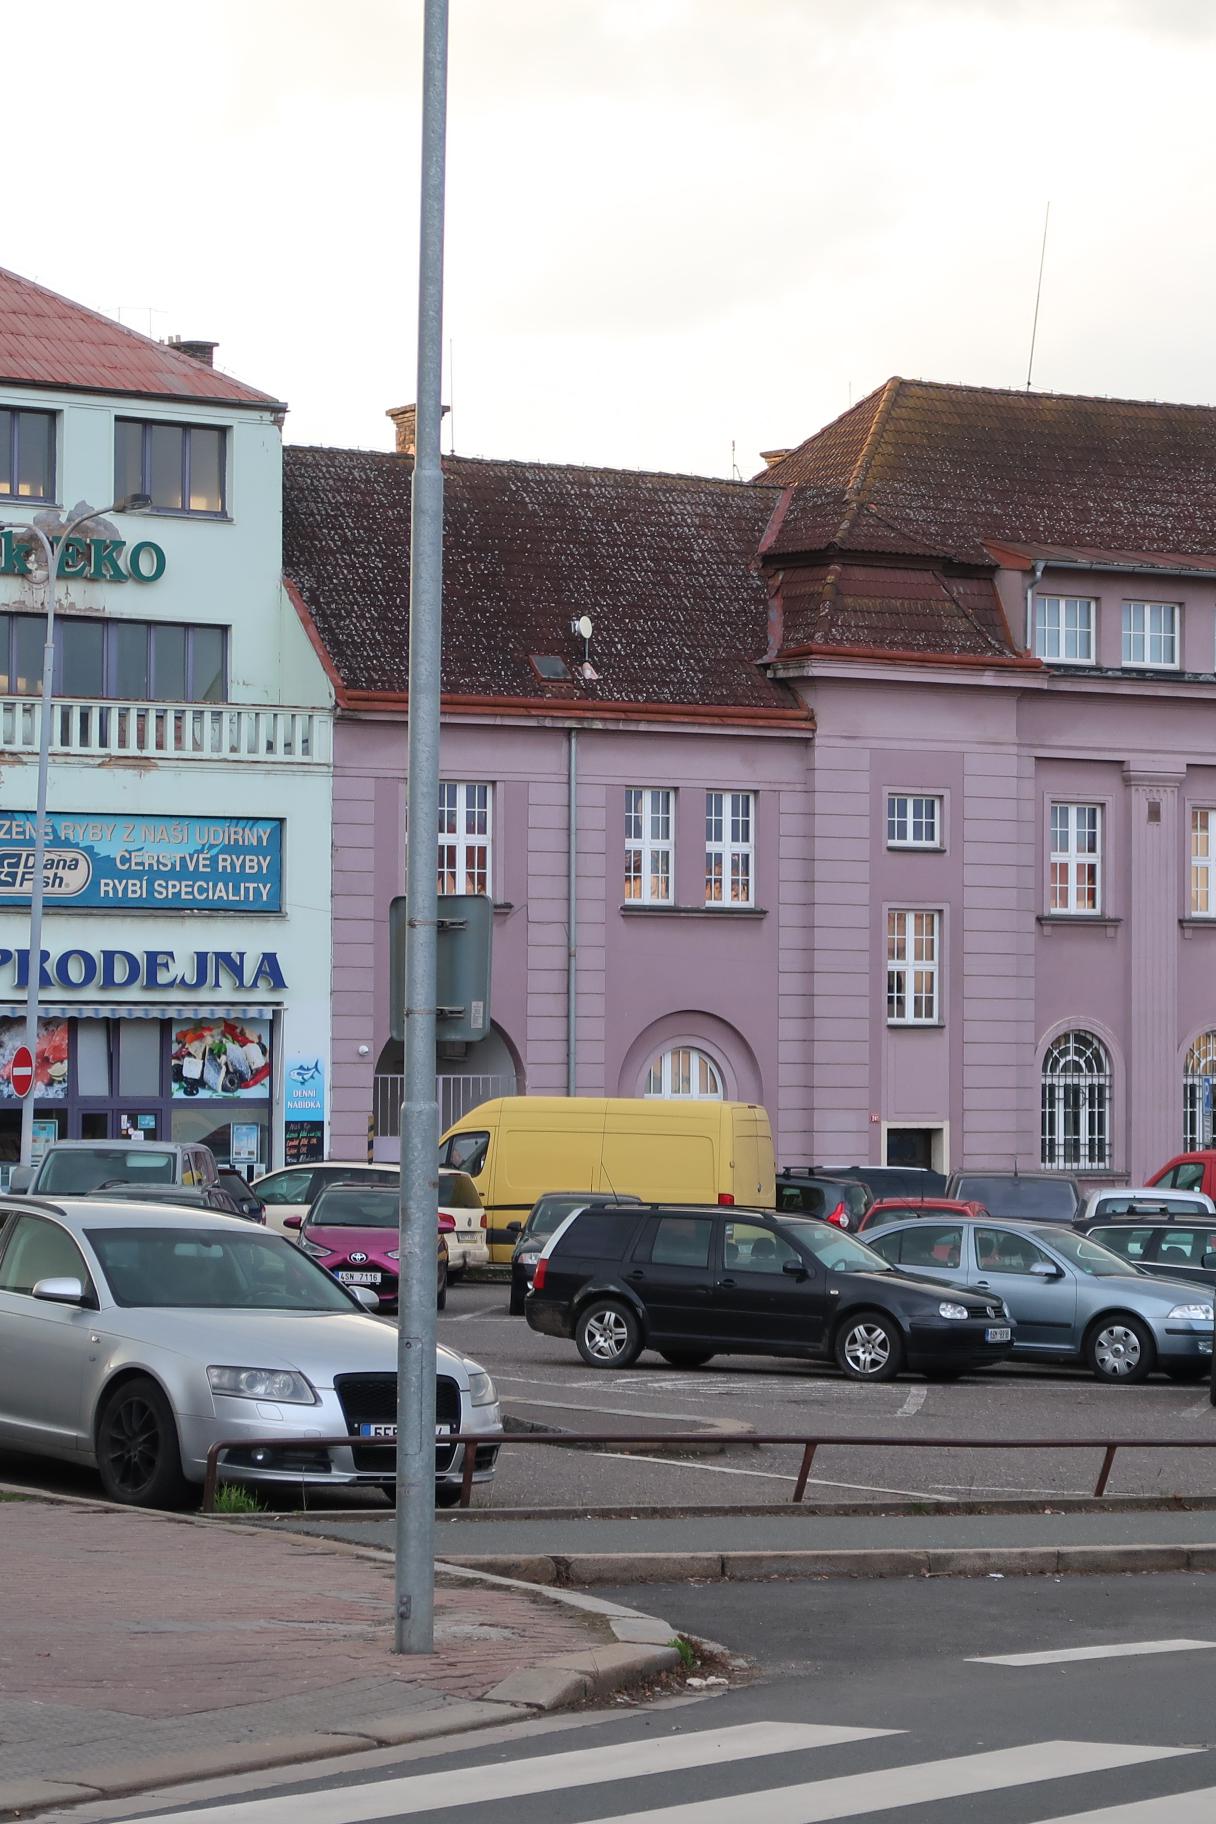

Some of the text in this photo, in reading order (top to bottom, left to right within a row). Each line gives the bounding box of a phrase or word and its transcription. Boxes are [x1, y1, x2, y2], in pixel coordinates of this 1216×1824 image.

[52, 536, 166, 583] EKO
[61, 822, 117, 841] RYBY
[123, 824, 136, 842] Z
[141, 822, 190, 844] NAŠÍ
[195, 823, 272, 847] UDÍRNY
[23, 853, 79, 871] Dana
[115, 848, 272, 874] ČERSTVÉ RYBY
[19, 871, 64, 889] Fsh
[100, 876, 272, 901] RYBÍ SPECIALITY
[293, 1088, 316, 1098] DENNÍ
[287, 1100, 321, 1109] NABÍDKA
